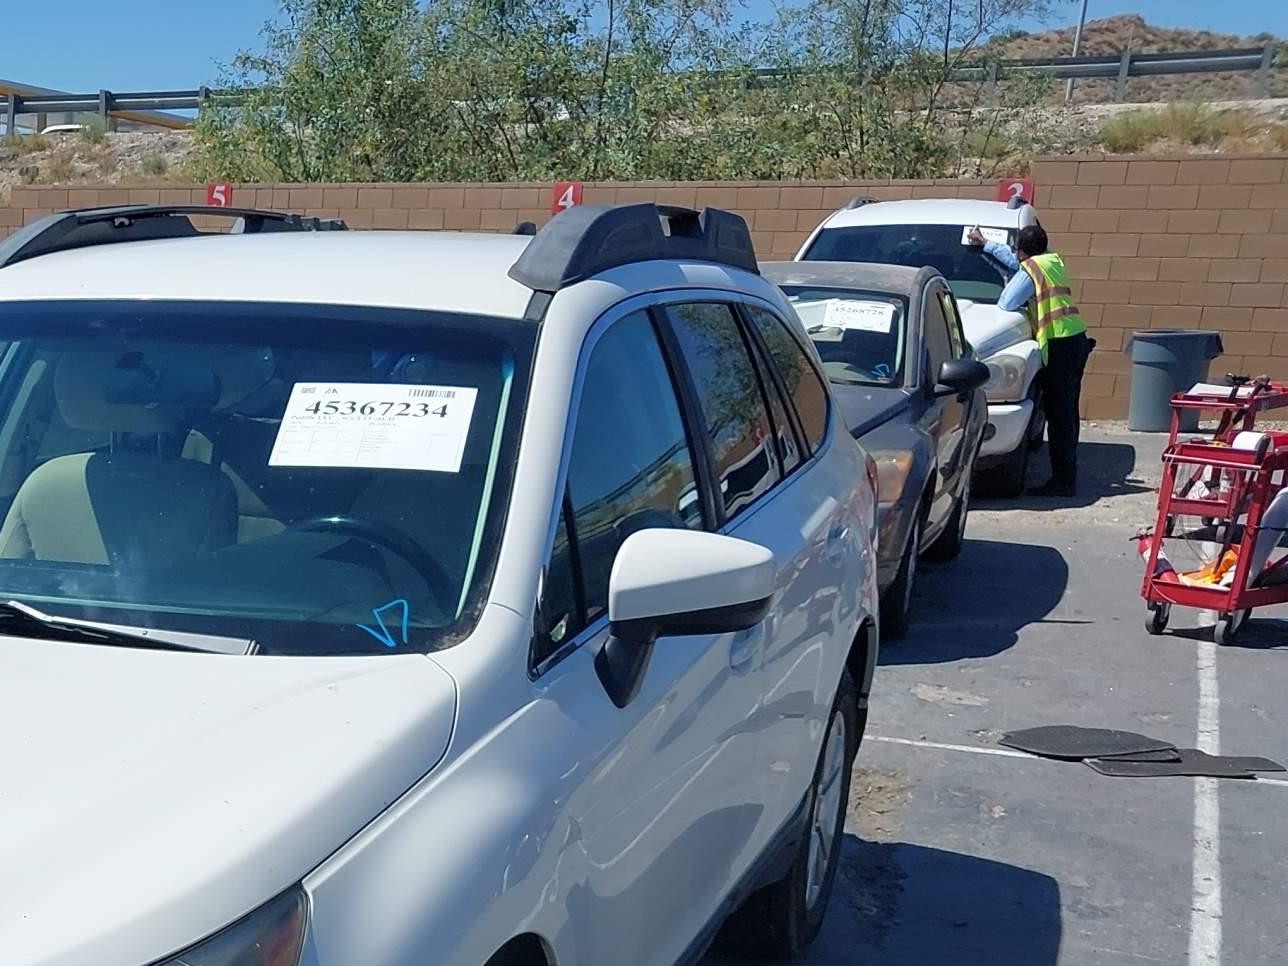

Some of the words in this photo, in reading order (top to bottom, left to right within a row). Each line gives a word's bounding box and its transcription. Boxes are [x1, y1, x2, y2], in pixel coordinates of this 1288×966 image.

[212, 185, 225, 207] 5
[558, 184, 575, 209] 4
[305, 400, 448, 418] 45367234
